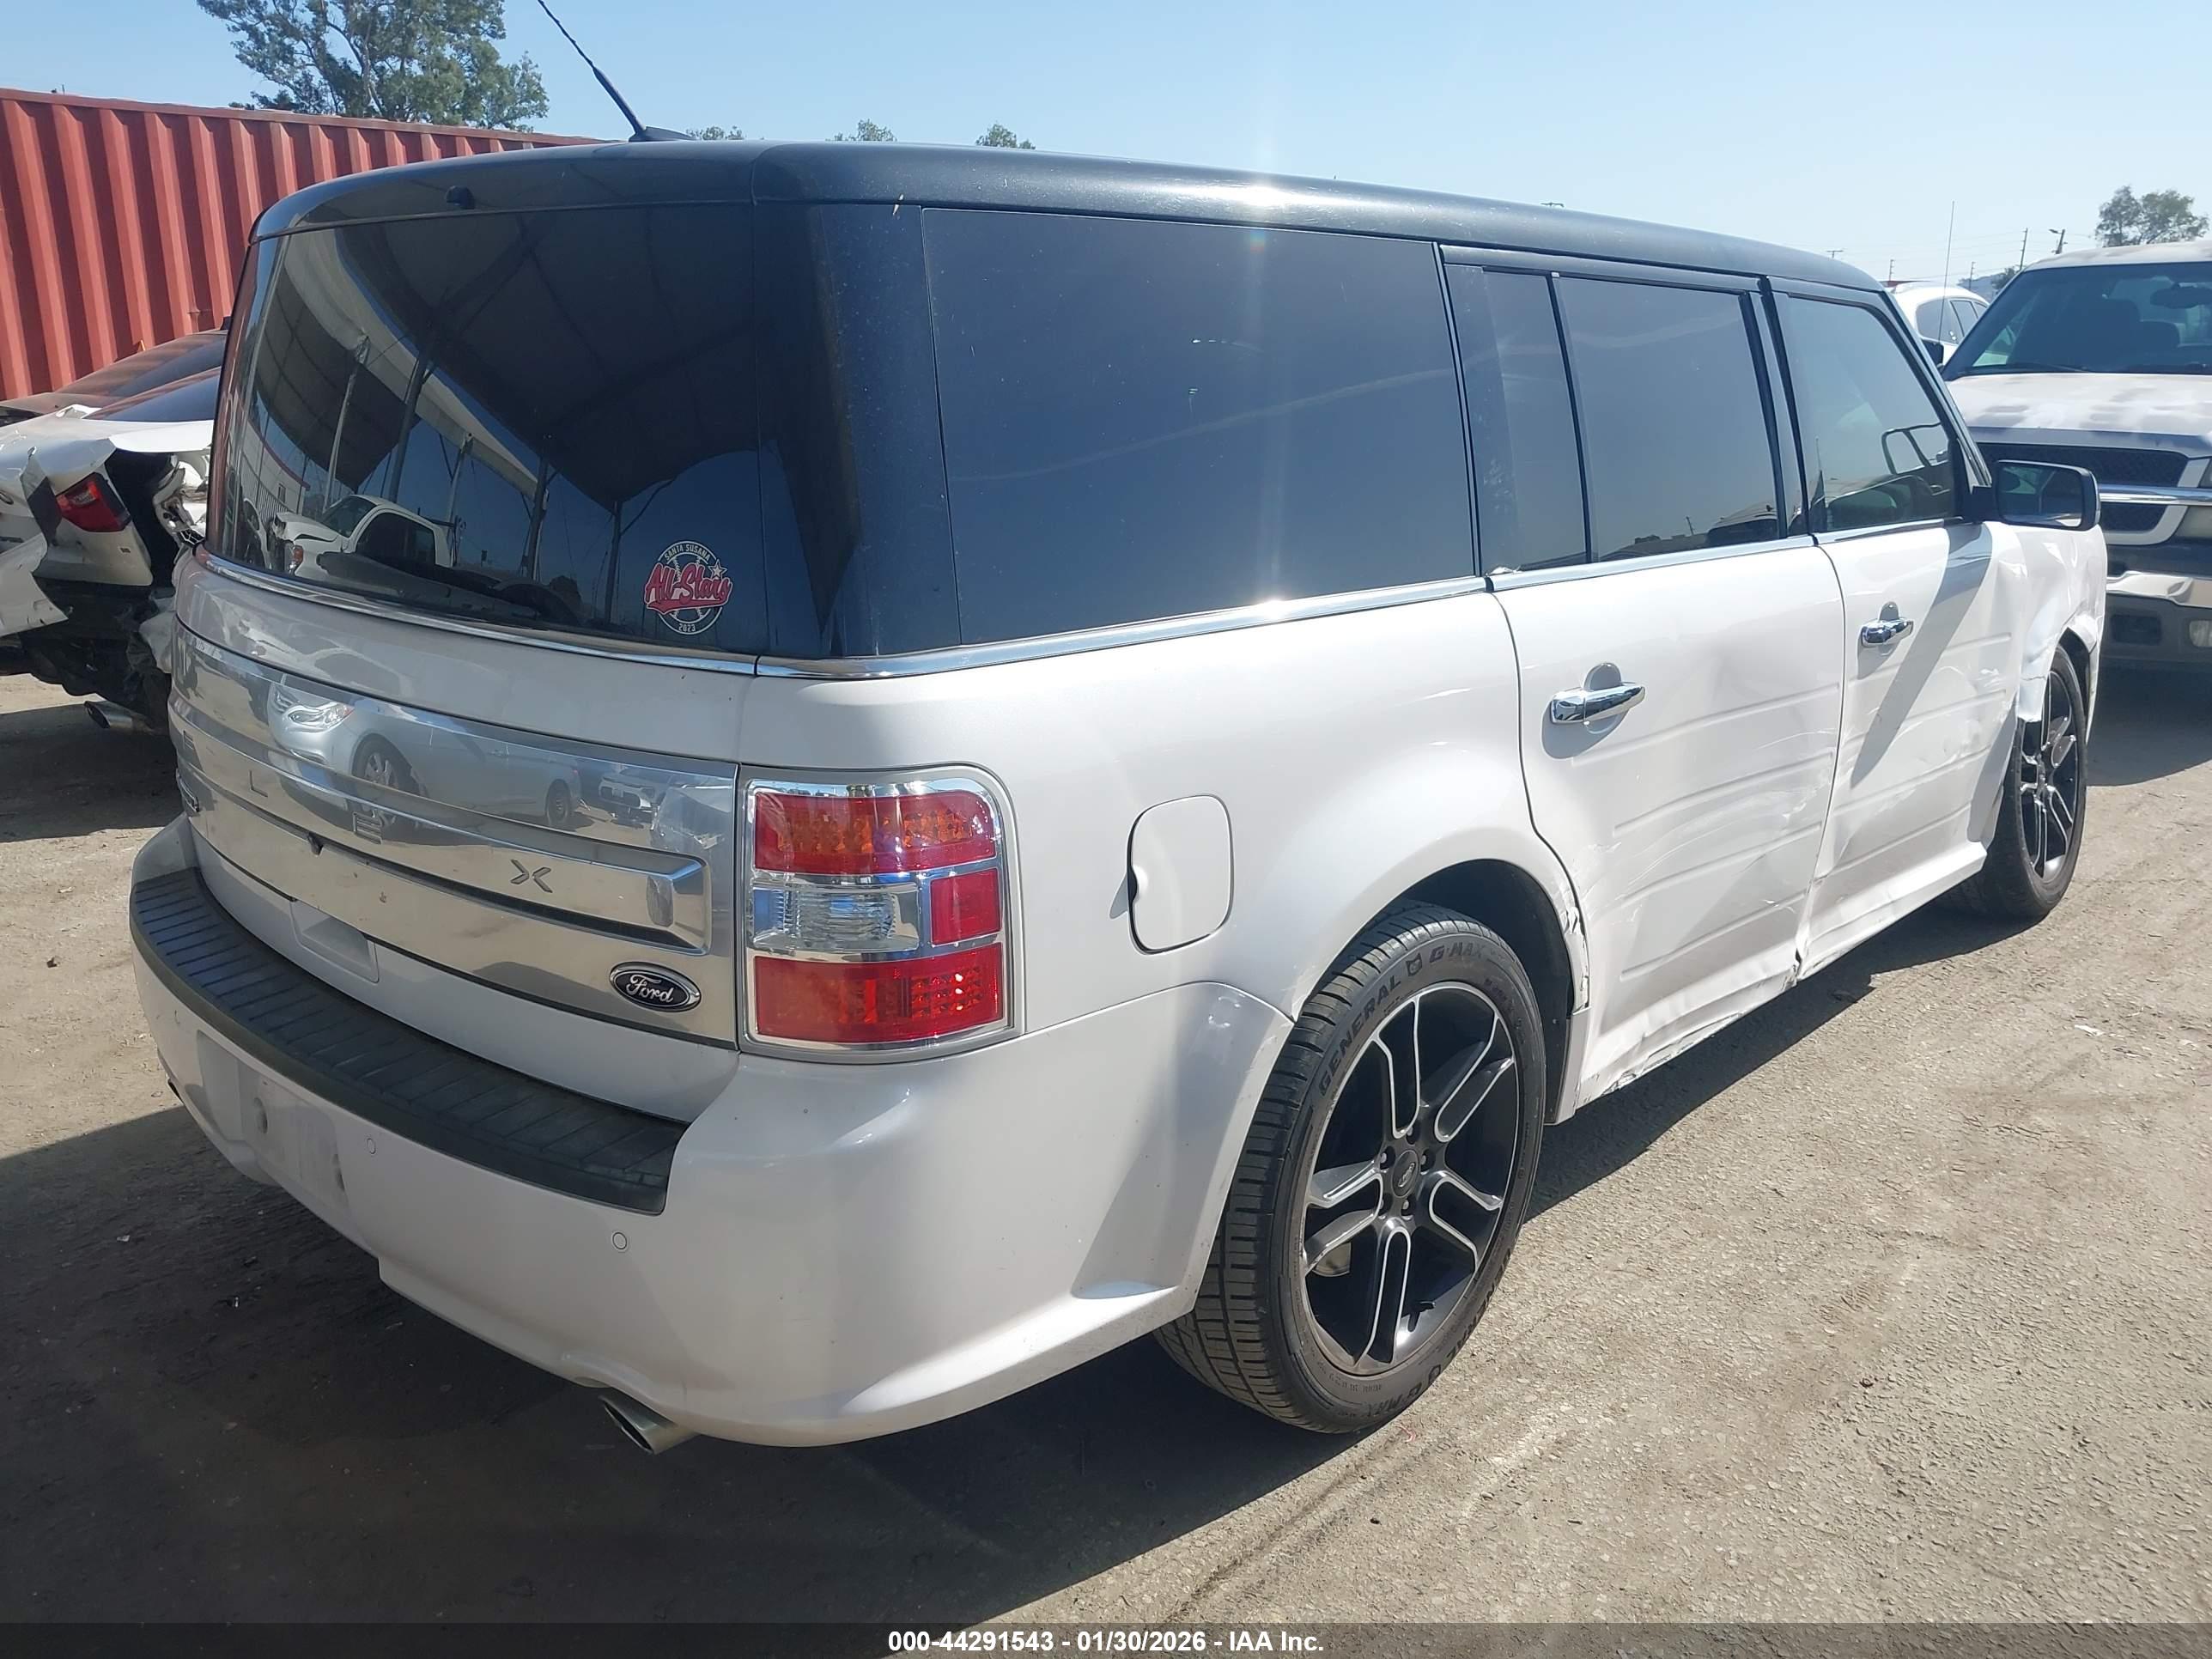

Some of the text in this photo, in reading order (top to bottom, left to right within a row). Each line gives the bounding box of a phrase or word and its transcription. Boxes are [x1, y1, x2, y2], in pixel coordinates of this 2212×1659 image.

[665, 544, 710, 561] SANTA SUSANA
[678, 623, 696, 633] 2023
[625, 973, 675, 1004] Ford
[1319, 975, 1401, 1097] GENERAL
